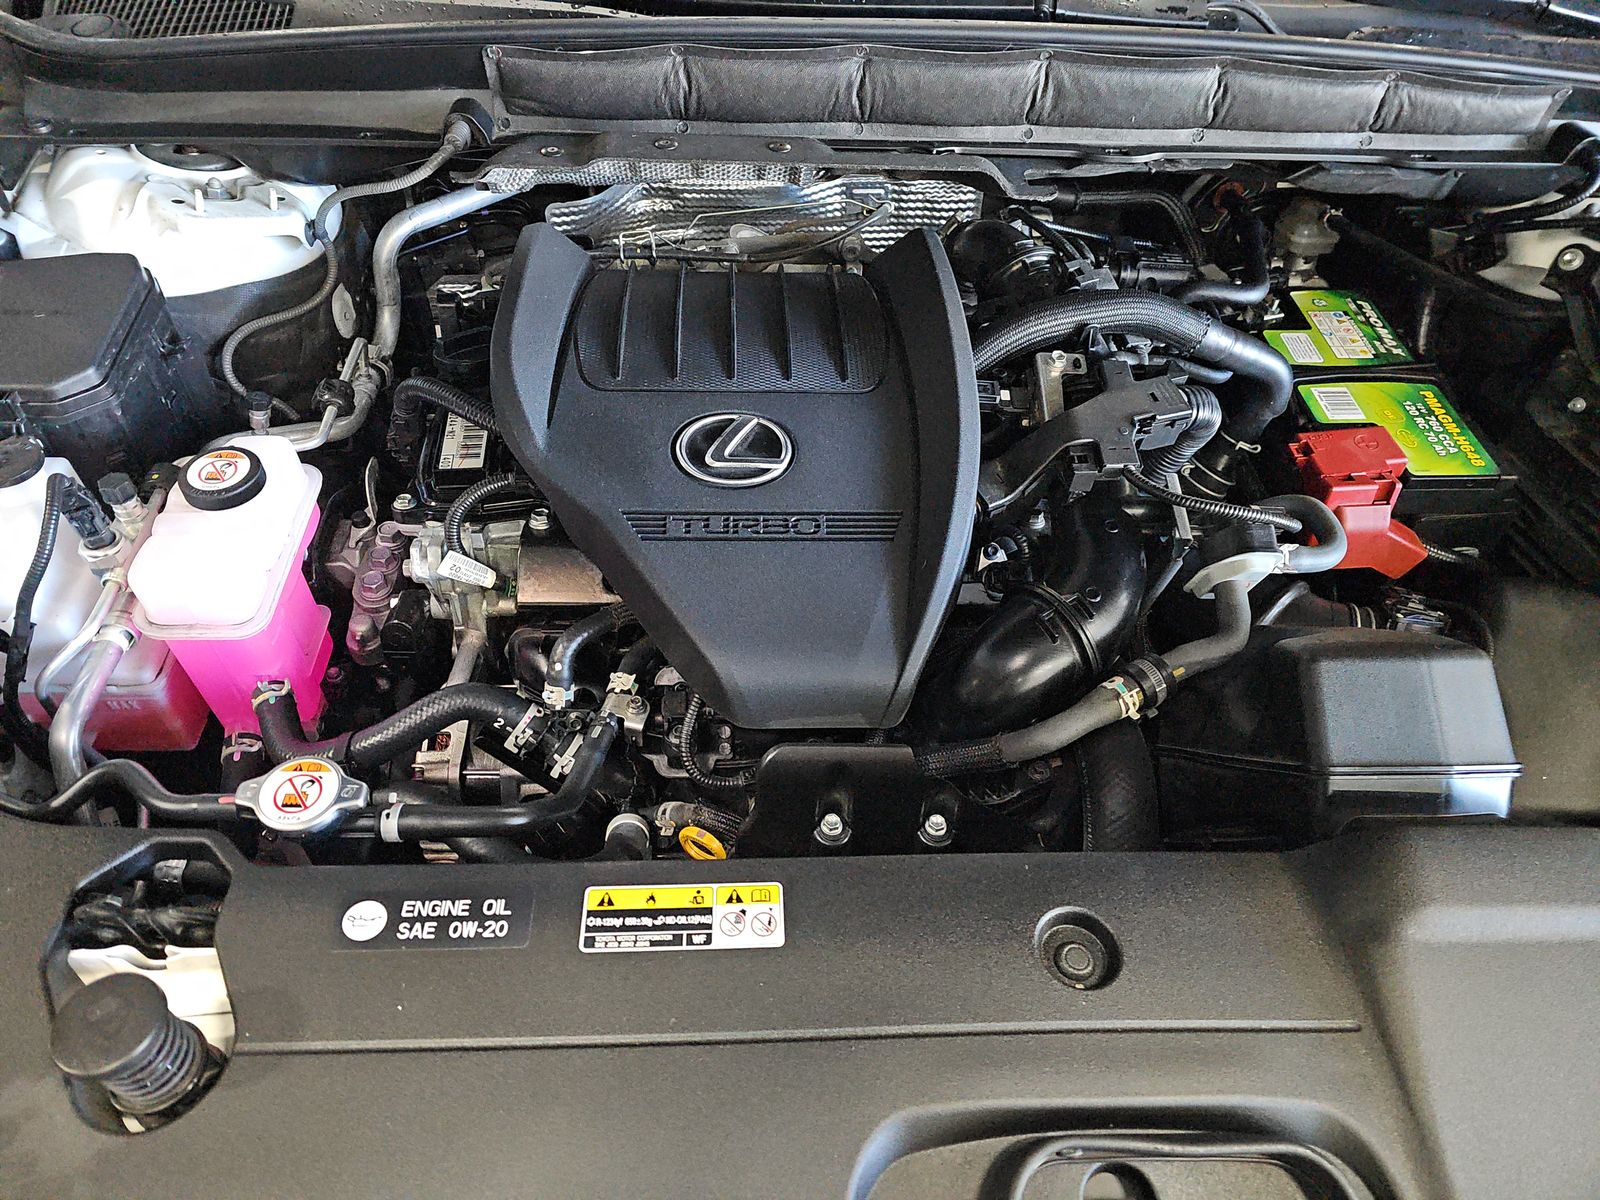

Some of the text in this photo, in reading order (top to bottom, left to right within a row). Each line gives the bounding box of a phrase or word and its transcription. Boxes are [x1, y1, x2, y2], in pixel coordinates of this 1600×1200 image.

[1356, 300, 1407, 357] PROMAX
[1403, 400, 1447, 457] 120 RC 70 Ah
[1419, 390, 1486, 467] PMAGM-H648
[1425, 415, 1443, 433] 760
[1438, 433, 1459, 454] CCA
[669, 514, 822, 536] TURBO
[450, 563, 461, 575] 02
[400, 898, 512, 918] ENGINE OIL
[396, 920, 509, 940] SAE 0W-20
[691, 934, 707, 945] WF
